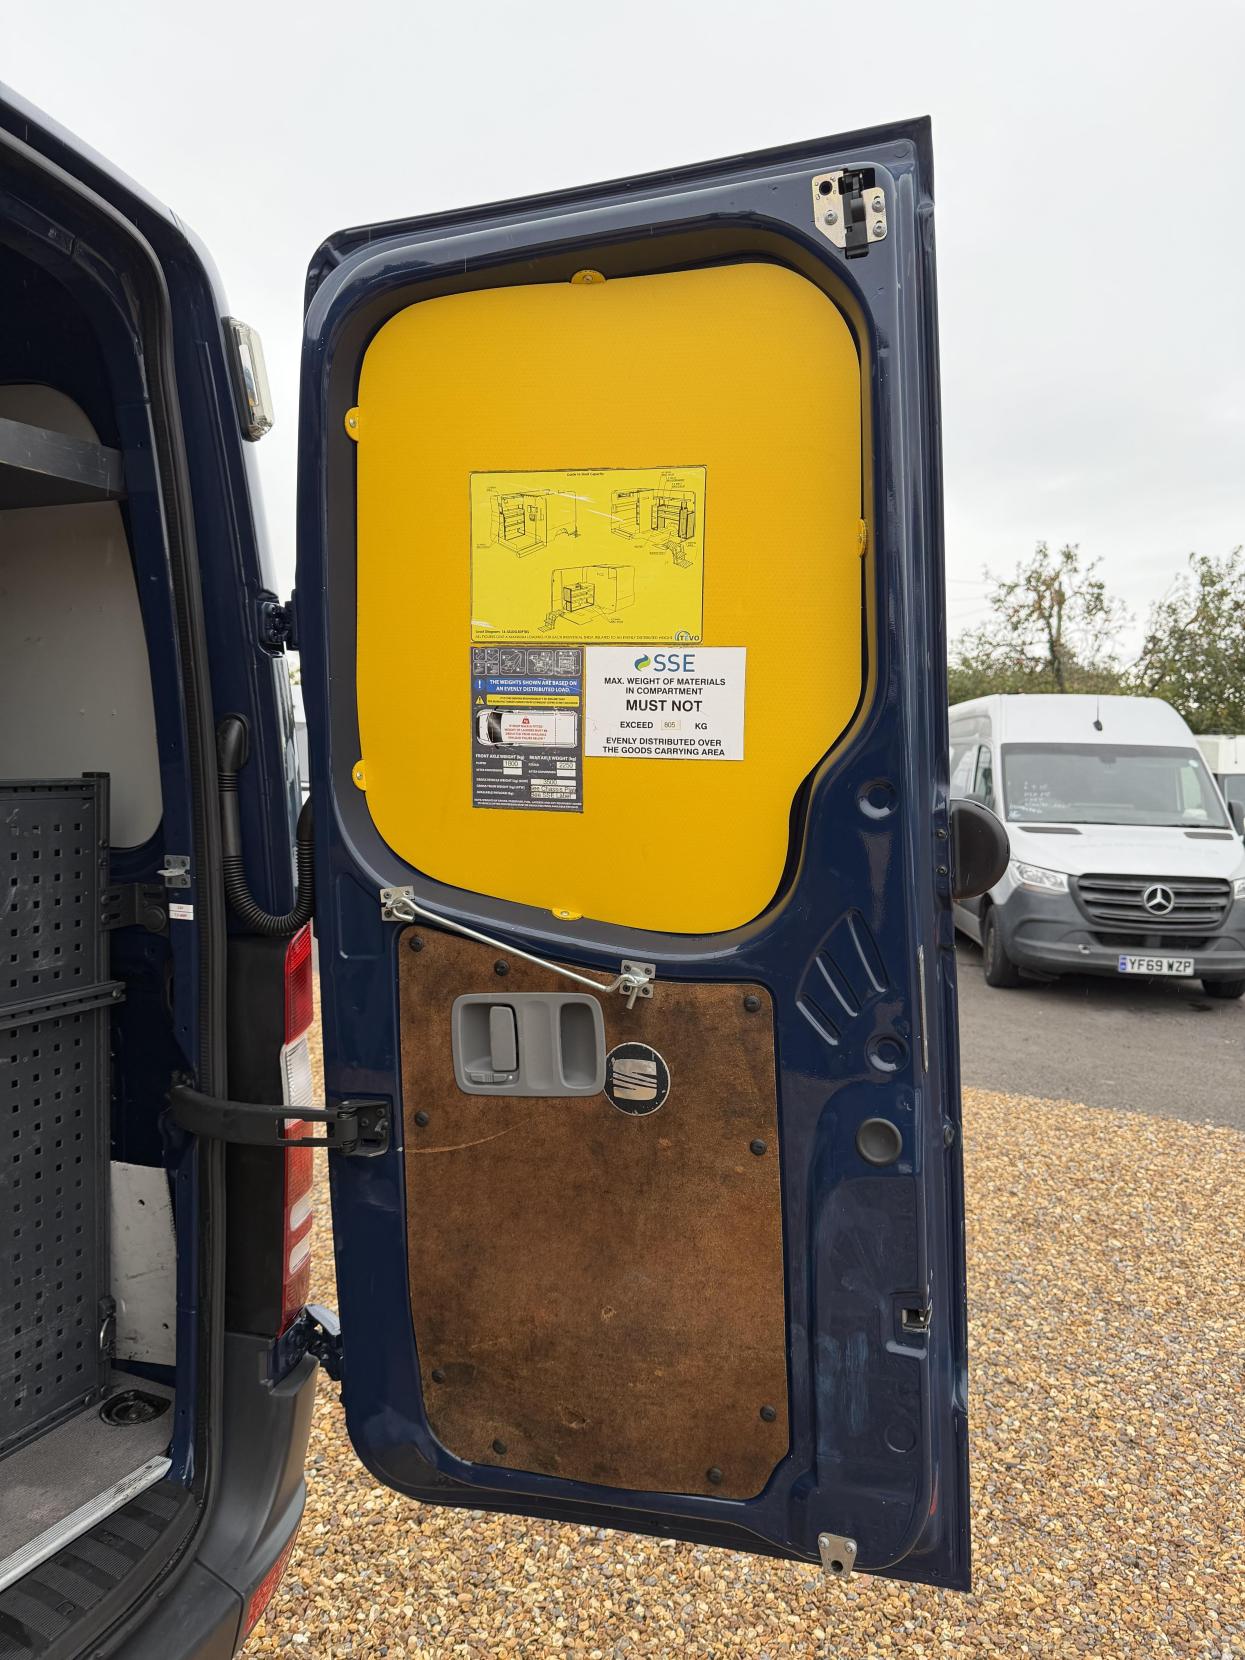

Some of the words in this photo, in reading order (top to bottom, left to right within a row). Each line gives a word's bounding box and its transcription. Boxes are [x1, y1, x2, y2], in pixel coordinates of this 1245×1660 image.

[653, 654, 696, 672] SSE
[626, 700, 667, 711] MUST
[671, 700, 702, 712] NOT
[1129, 958, 1163, 972] YF69
[1168, 960, 1191, 972] WZP
